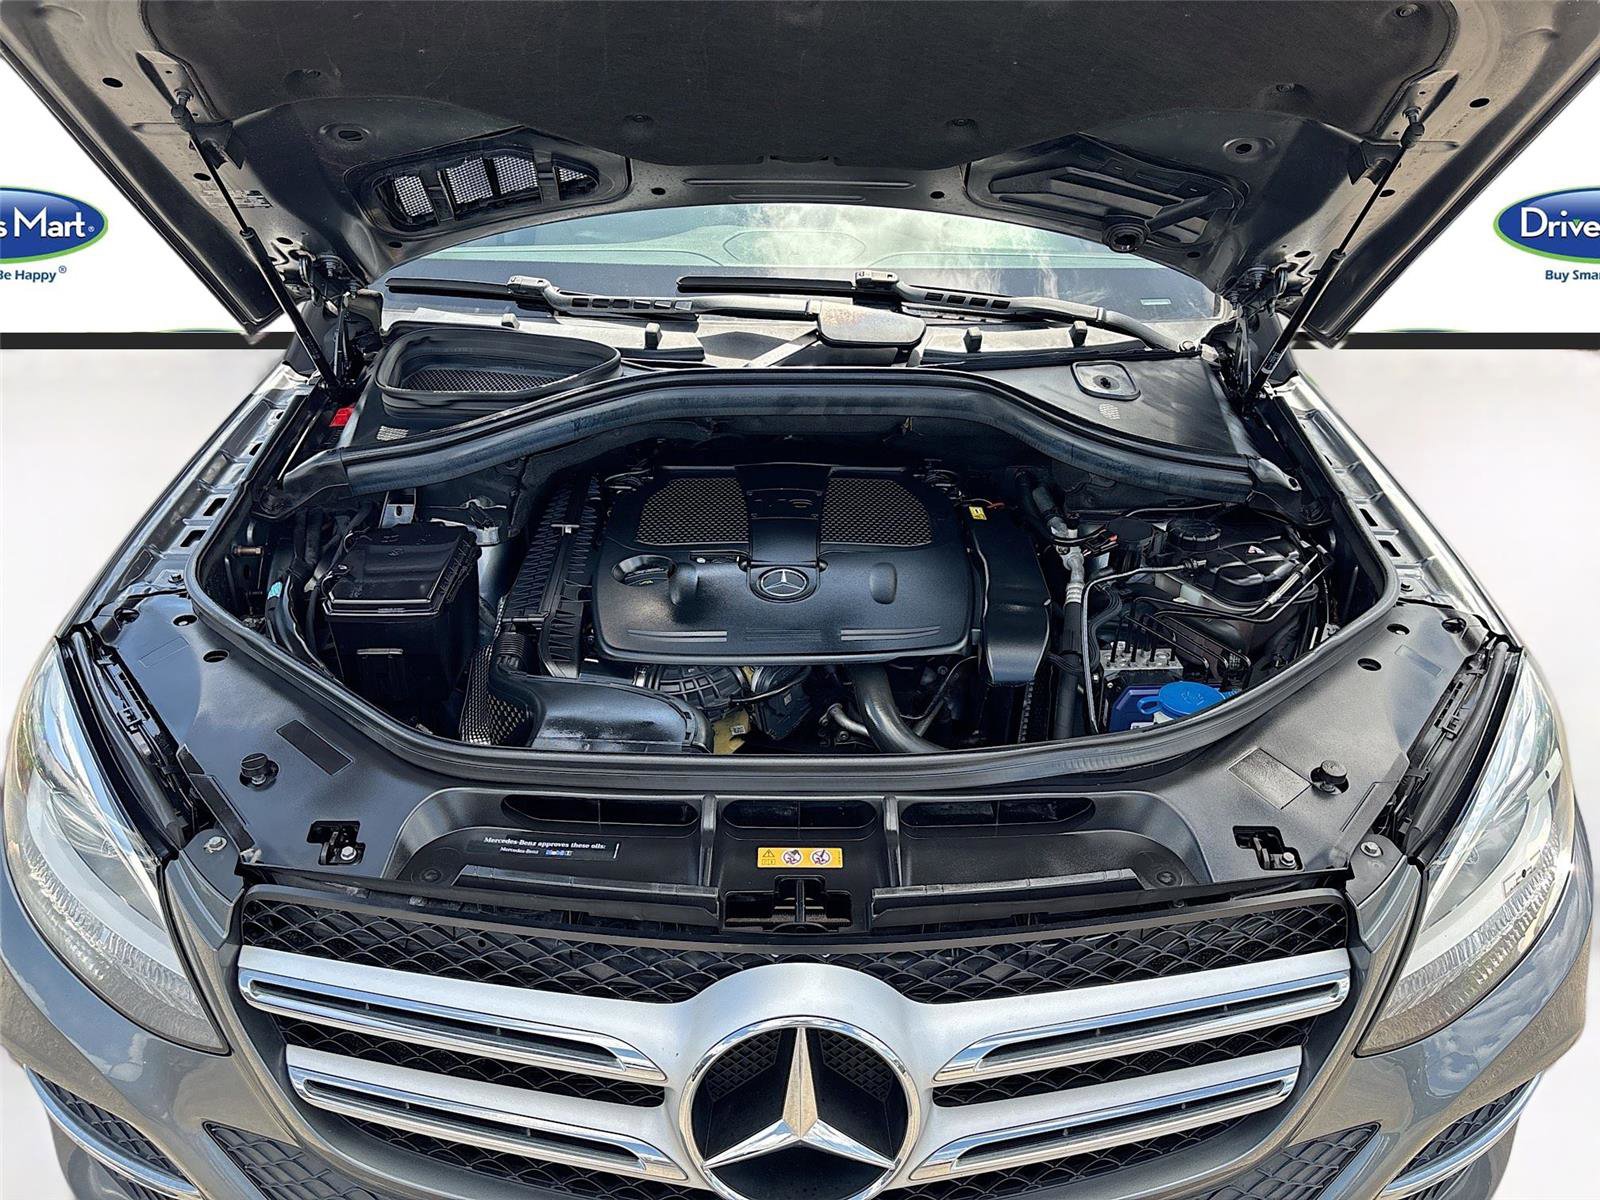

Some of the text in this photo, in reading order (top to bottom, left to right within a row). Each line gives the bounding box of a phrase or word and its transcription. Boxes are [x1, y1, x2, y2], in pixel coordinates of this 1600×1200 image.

[1521, 206, 1600, 238] Drive
[1545, 270, 1570, 283] Buy
[484, 837, 537, 847] Mercedes-Benz
[537, 841, 569, 849] approves
[570, 842, 589, 850] these
